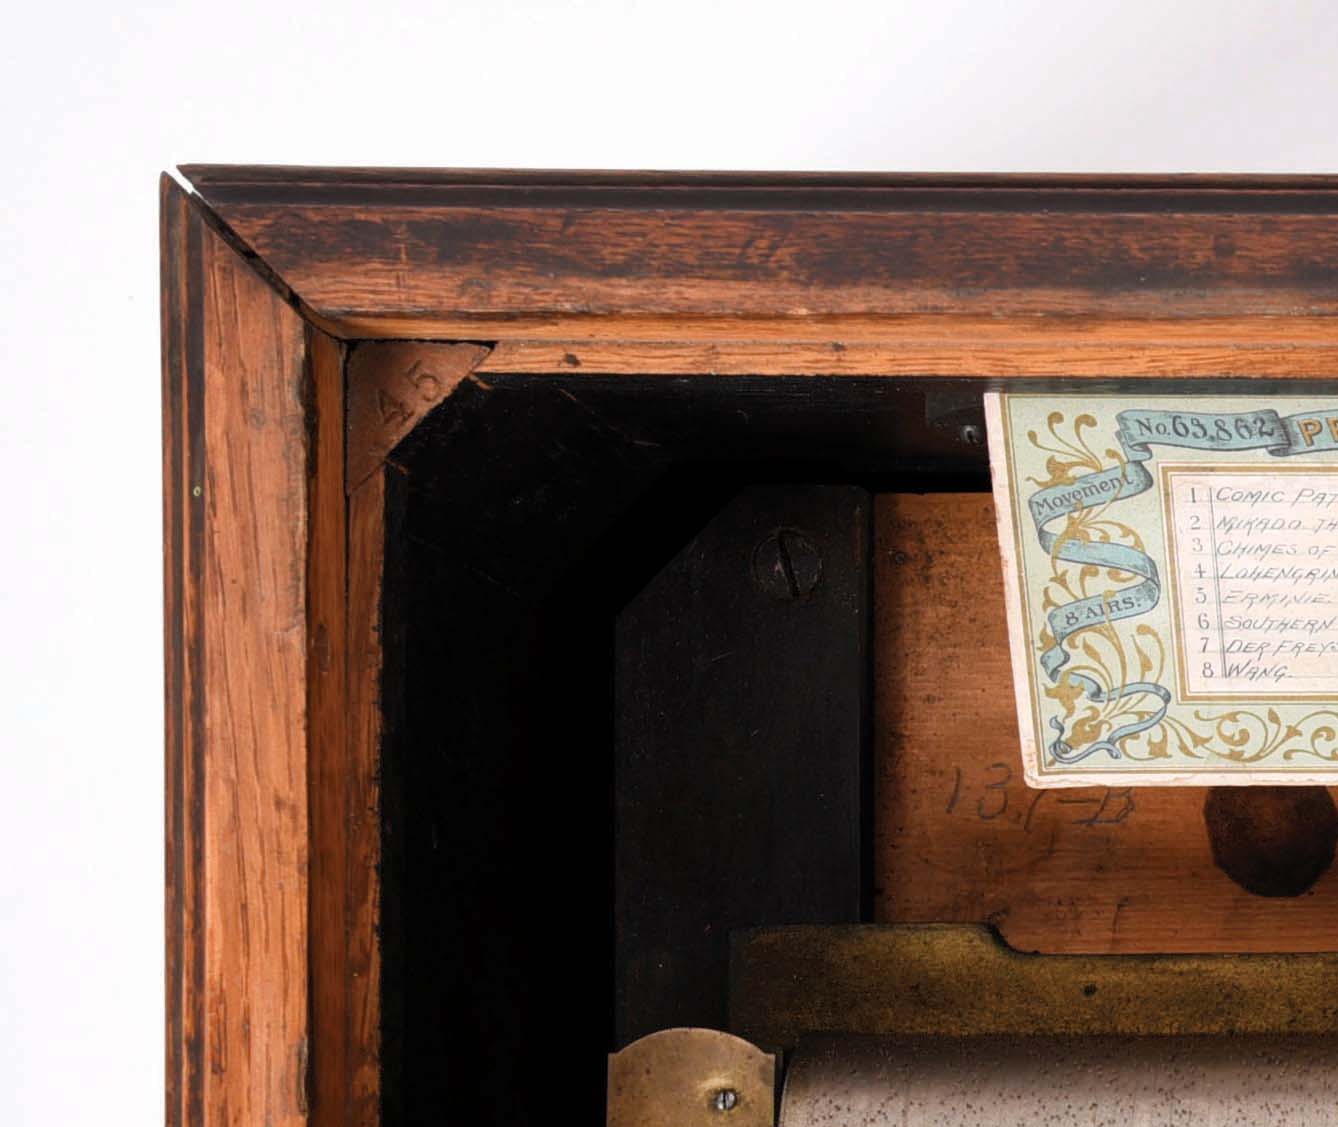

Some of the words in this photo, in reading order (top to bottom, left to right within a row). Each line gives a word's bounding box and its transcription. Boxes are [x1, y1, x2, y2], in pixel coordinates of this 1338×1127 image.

[1035, 474, 1134, 516] Movement
[1190, 487, 1198, 504] 1
[1216, 486, 1285, 506] COMIC
[1189, 515, 1202, 531] 2
[1191, 537, 1204, 553] 3
[1216, 540, 1298, 562] CHIMES
[1307, 544, 1337, 562] OF
[1193, 563, 1207, 580] 4
[1194, 587, 1207, 604] 5
[1065, 611, 1080, 627] 8
[1086, 596, 1143, 620] AIRS.
[1197, 612, 1211, 630] 6
[1223, 615, 1338, 634] SOUTHERN
[1199, 637, 1211, 654] 7
[1225, 638, 1271, 660] DER
[1201, 662, 1215, 679] 8
